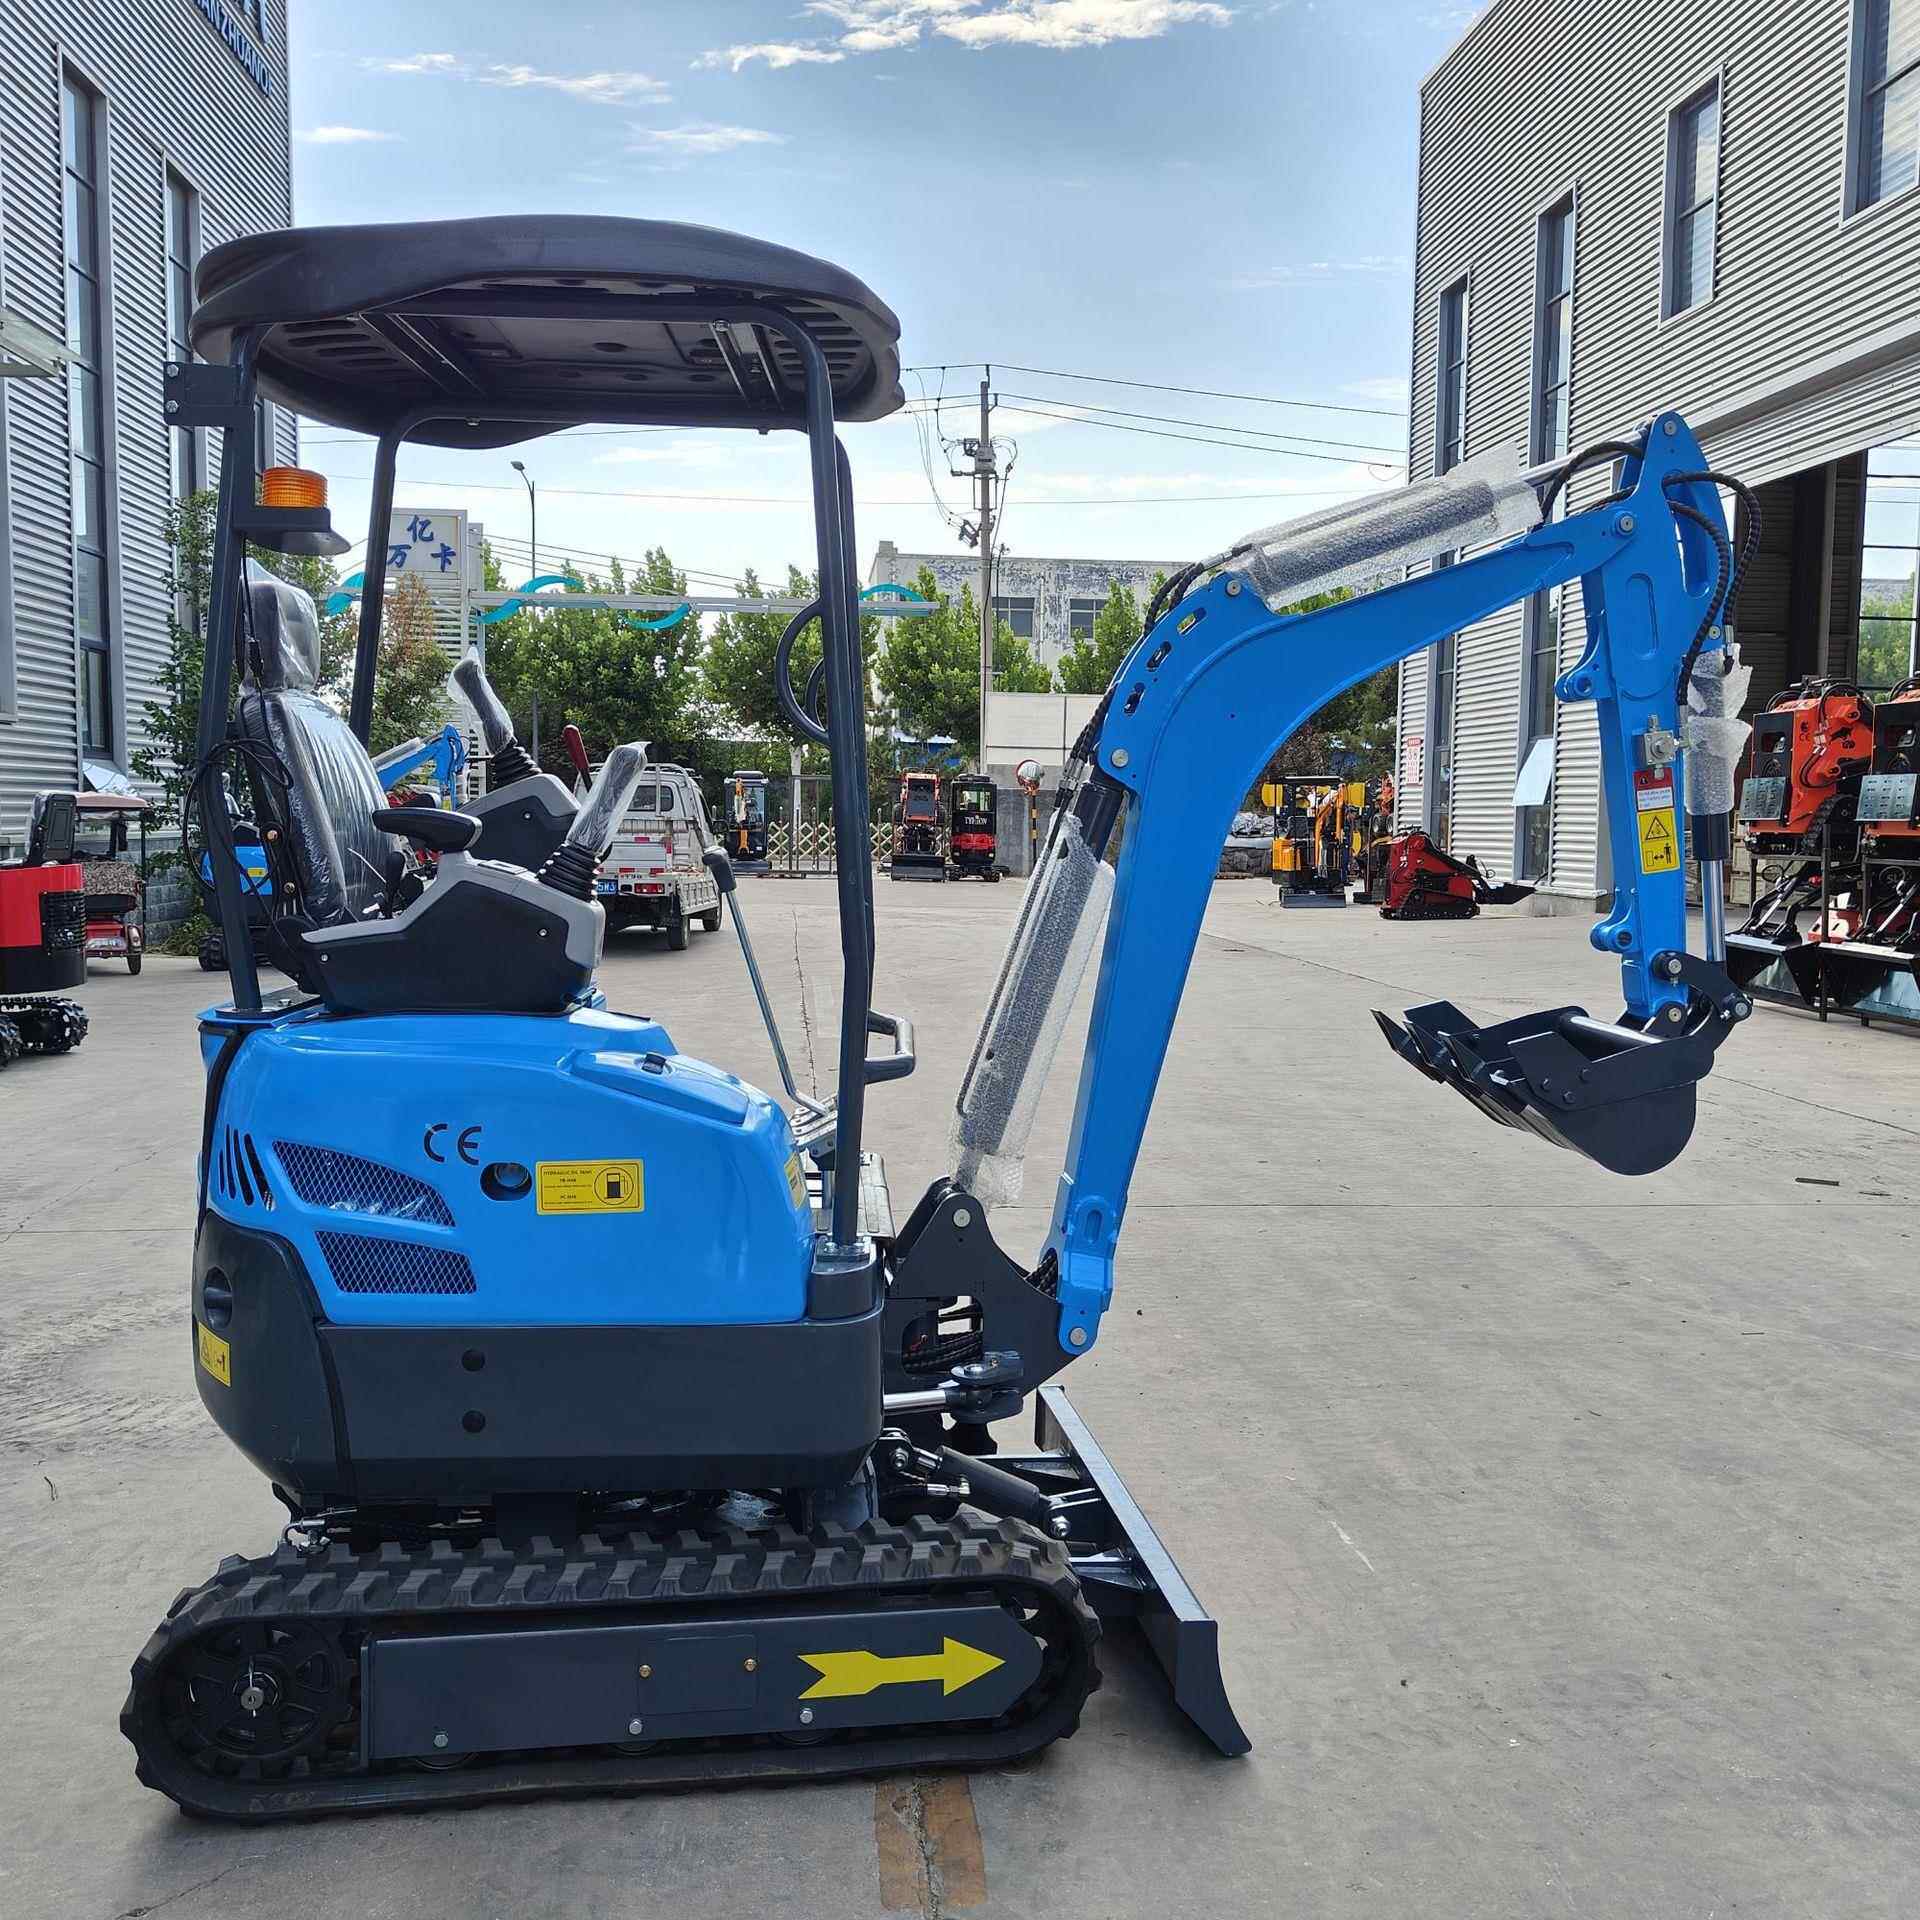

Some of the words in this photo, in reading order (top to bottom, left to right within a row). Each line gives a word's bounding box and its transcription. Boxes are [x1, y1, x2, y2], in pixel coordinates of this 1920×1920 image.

[407, 514, 434, 543] 亿
[387, 544, 412, 568] 万
[430, 542, 456, 573] 卡
[423, 1123, 482, 1166] CE
